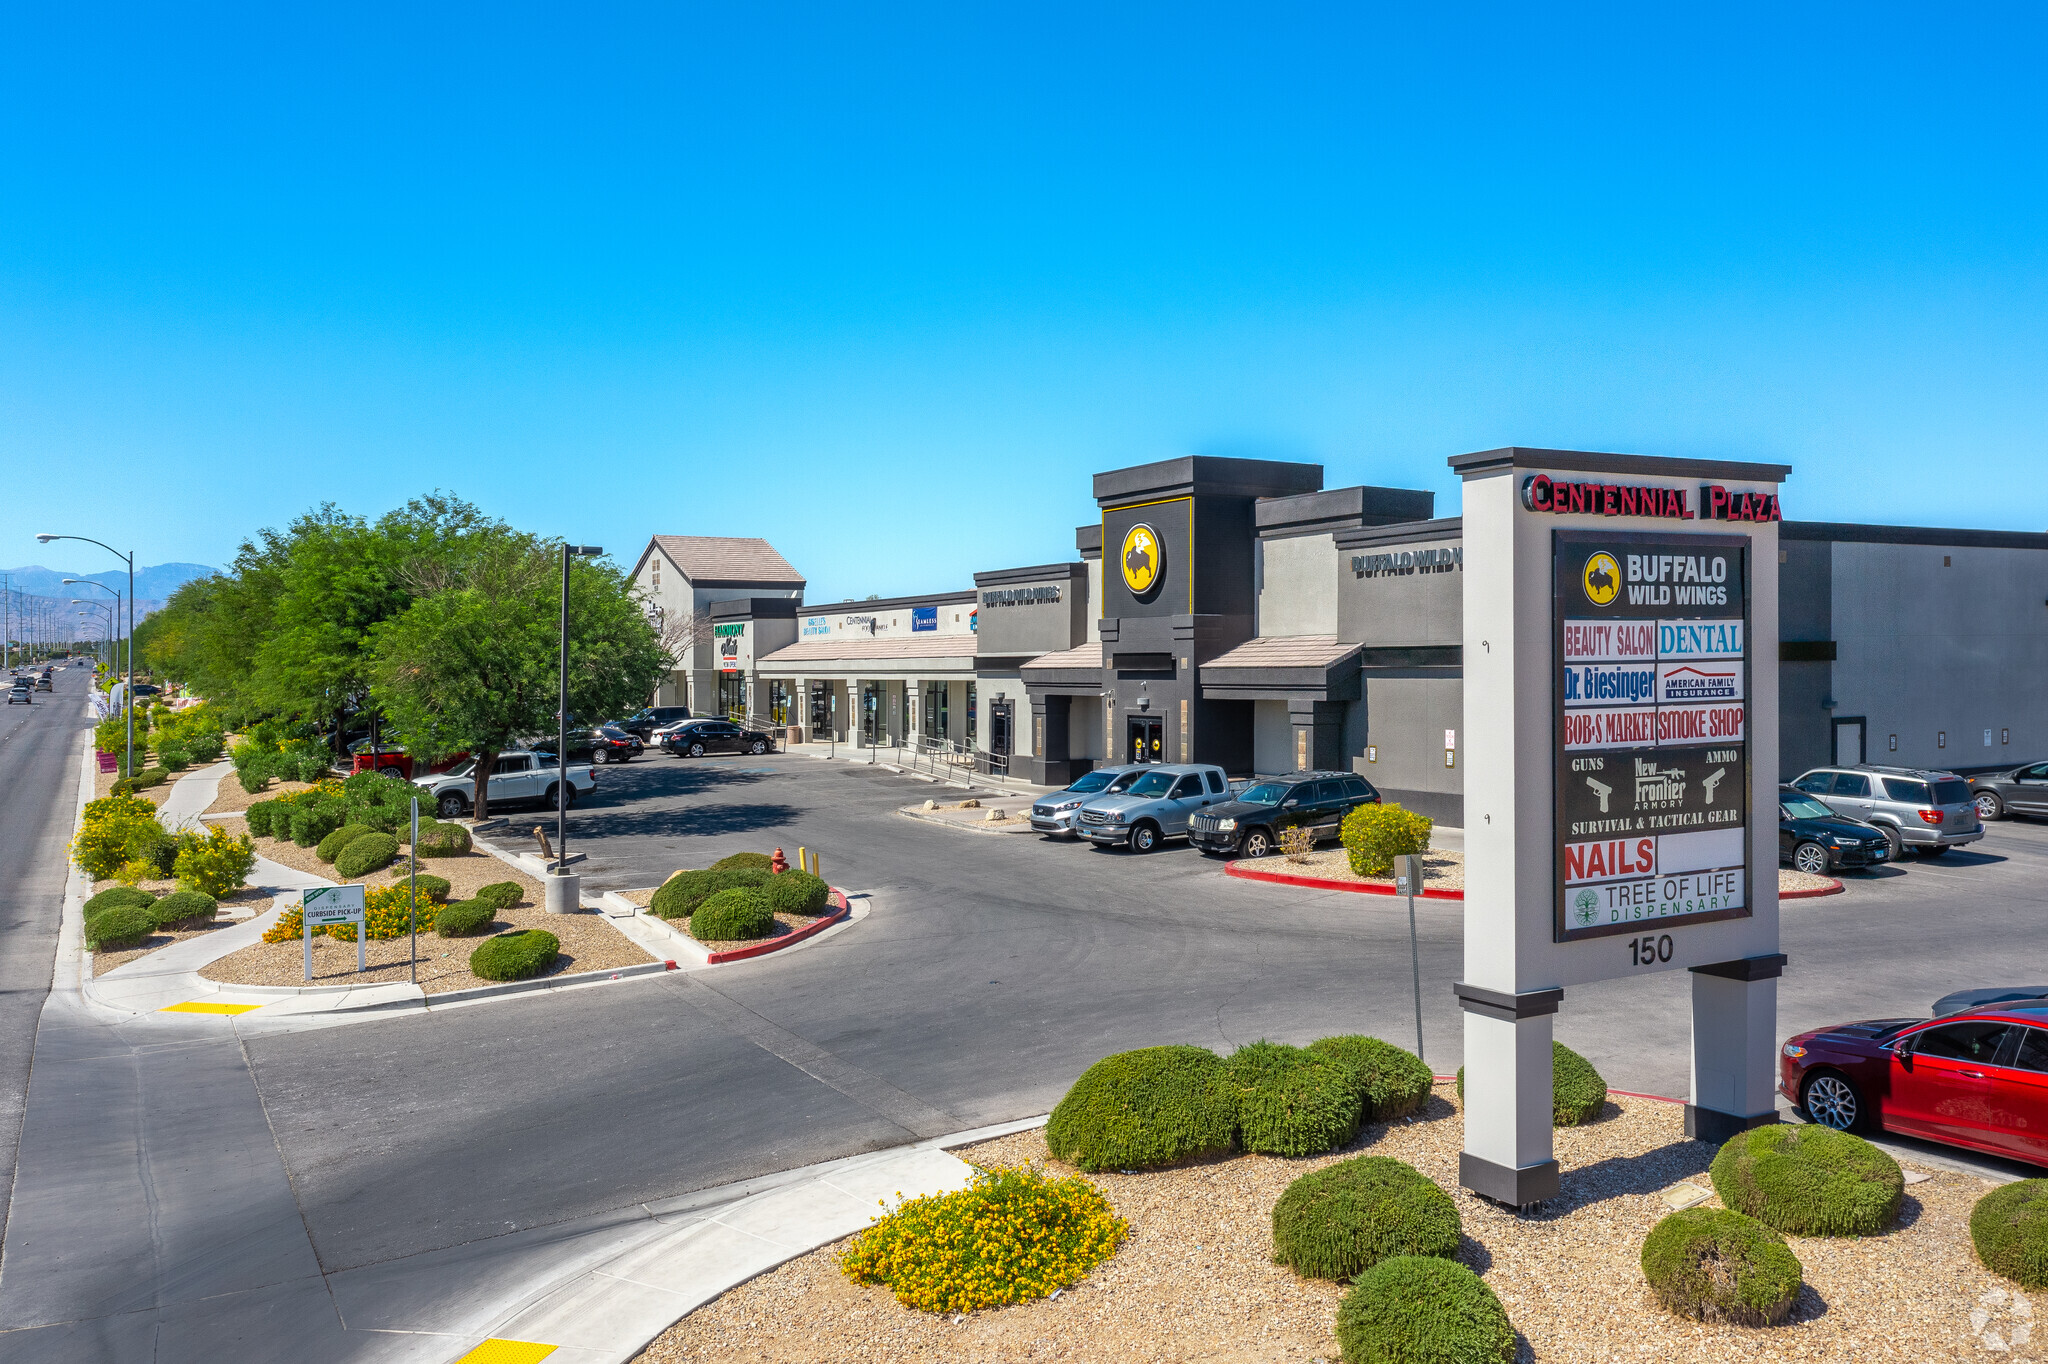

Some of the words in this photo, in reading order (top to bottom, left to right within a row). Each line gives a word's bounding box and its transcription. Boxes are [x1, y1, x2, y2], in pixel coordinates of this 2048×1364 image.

[1526, 474, 1694, 519] CENTENNIAL
[1706, 485, 1783, 522] PLAZA
[1352, 552, 1412, 573] BUFFALO
[1413, 548, 1452, 568] WILD
[1627, 555, 1726, 583] BUFFALO
[983, 590, 1013, 604] BUFFALO
[1014, 588, 1032, 601] WILD
[1628, 586, 1670, 605] WILD
[1675, 586, 1727, 605] WINGS
[1566, 626, 1612, 656] BEAUTY
[1617, 625, 1653, 655] SALON
[1660, 624, 1742, 654] DENTAL
[1565, 667, 1581, 700] Dr.
[1585, 666, 1655, 702] Biesinger
[1666, 679, 1706, 688] AMERICAN
[1708, 678, 1735, 687] FAMILY
[1671, 689, 1730, 697] INSURANCE
[1565, 714, 1602, 745] BOB'S
[1606, 712, 1656, 743] MARKET
[1659, 709, 1706, 741] SMOKE
[1709, 708, 1743, 737] SHOP
[1572, 758, 1604, 771] GUNS
[1706, 750, 1737, 763] AMMO
[1634, 800, 1683, 811] ARMORY
[1572, 818, 1632, 835] SURVIVAL
[1636, 817, 1644, 829] &
[1649, 812, 1704, 828] TACTICAL
[1708, 809, 1737, 823] GEAR
[1566, 839, 1653, 881] NAILS
[1605, 882, 1656, 908] TREE
[1664, 878, 1689, 900] OF
[1697, 873, 1735, 897] LIFE
[308, 910, 336, 918] CURBSIDE
[338, 908, 361, 916] PICK-UP
[1611, 895, 1730, 922] DISPENSARY
[1628, 934, 1674, 966] 150
